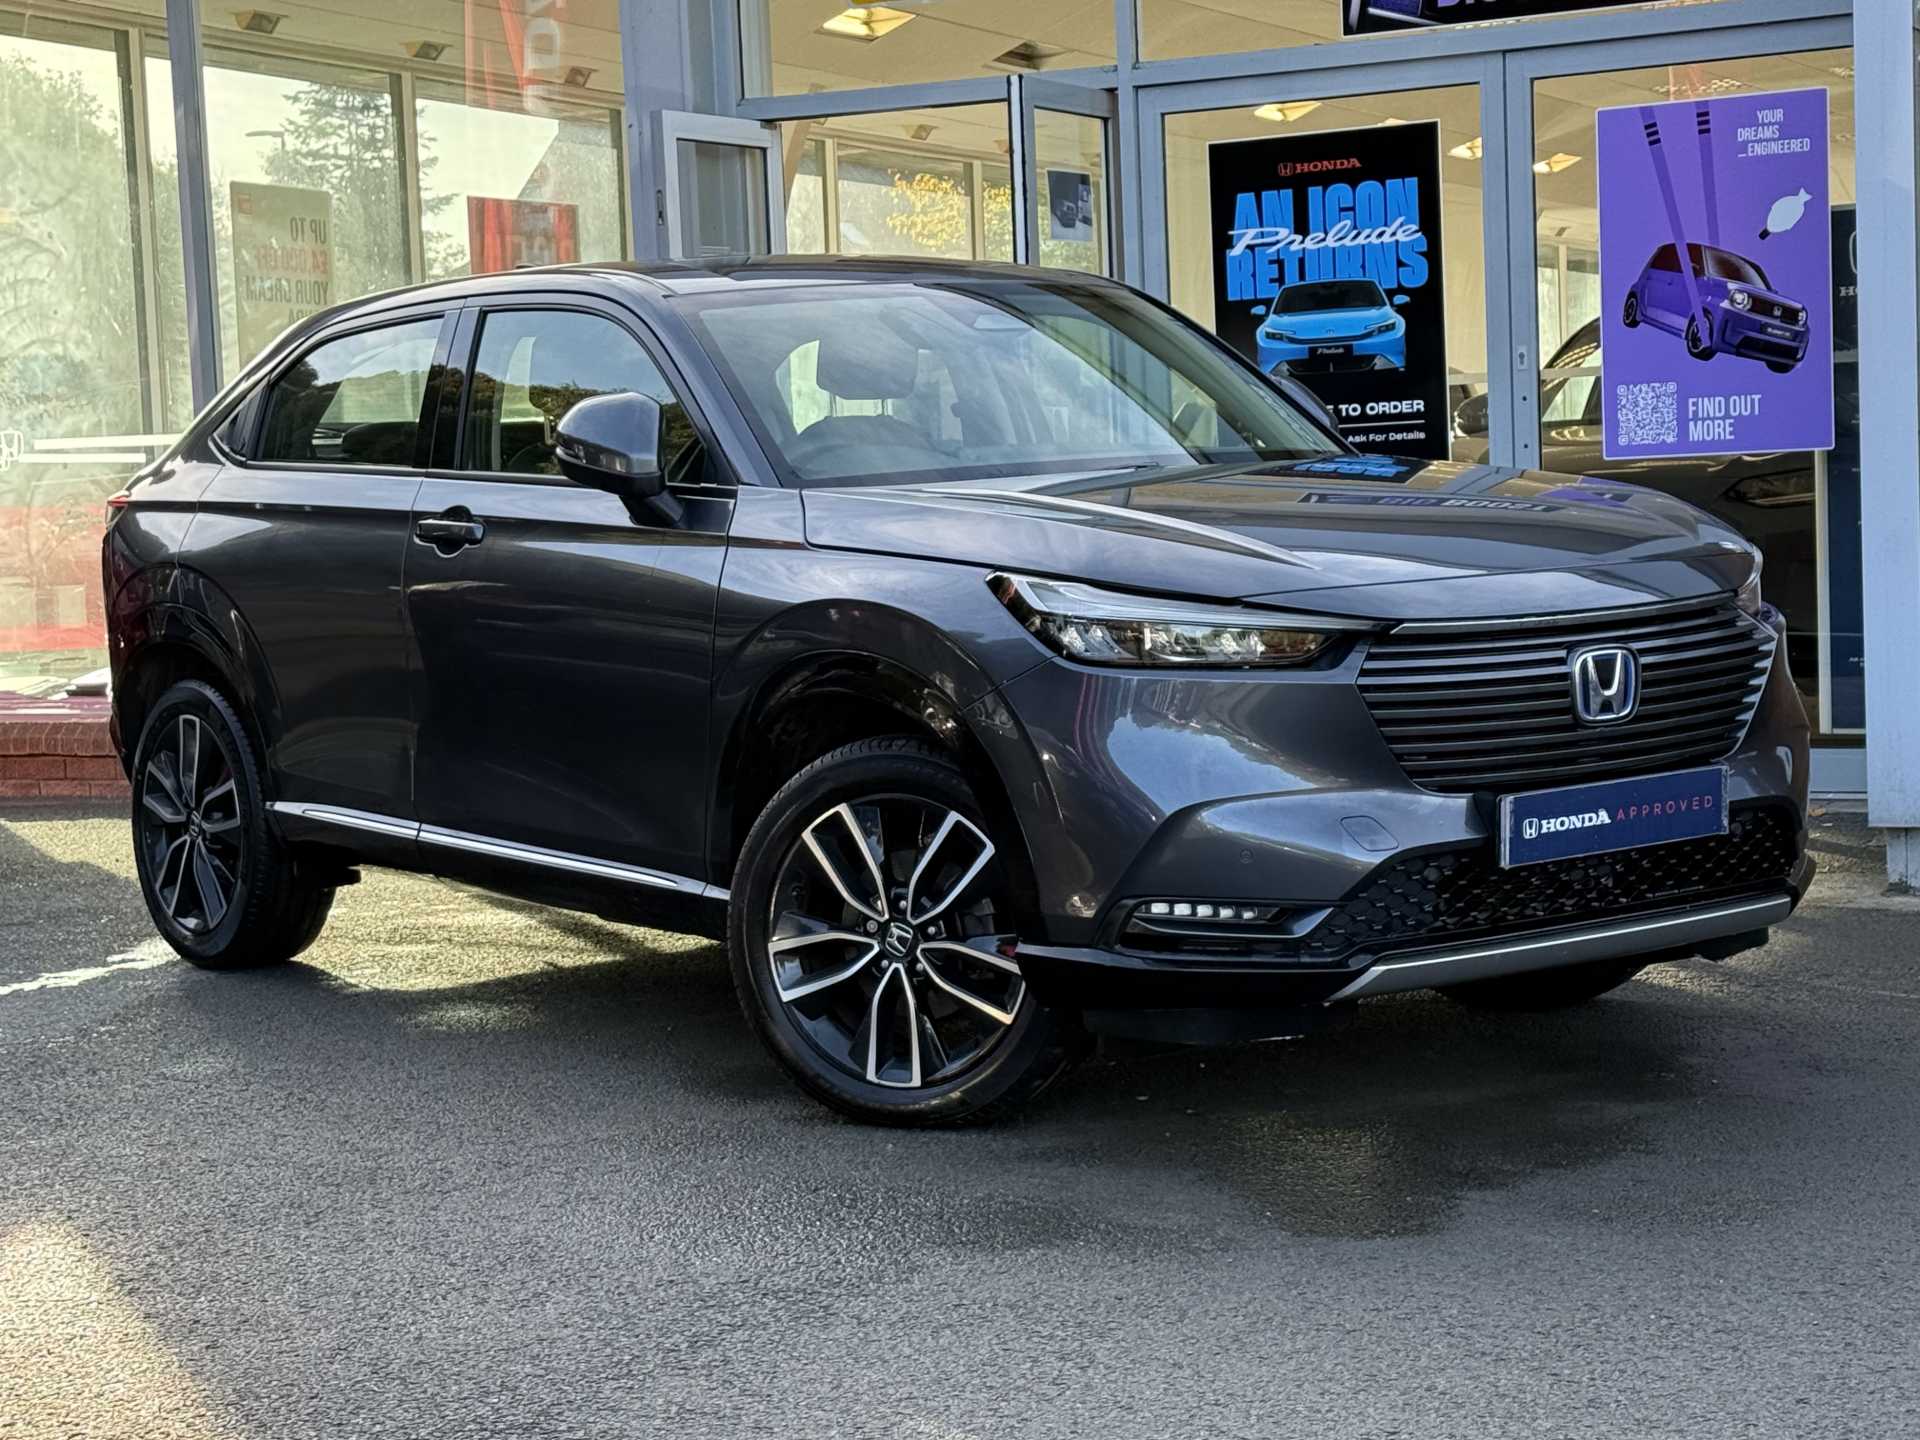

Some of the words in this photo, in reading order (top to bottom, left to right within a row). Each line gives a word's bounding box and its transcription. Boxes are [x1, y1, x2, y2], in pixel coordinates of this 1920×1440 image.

[1757, 109, 1784, 123] YOUR
[1737, 125, 1780, 141] DREAMS
[1295, 157, 1362, 174] HONDA
[1232, 188, 1294, 247] AN
[1308, 176, 1419, 238] ICON
[1227, 216, 1423, 256] Prelude
[1225, 234, 1429, 301] RETURNS
[1338, 403, 1362, 417] TO
[1365, 399, 1425, 416] ORDER
[1688, 396, 1726, 419] FIND
[1729, 394, 1762, 417] OUT
[1347, 434, 1367, 443] Ask
[1369, 432, 1387, 442] For
[1388, 430, 1426, 441] Details
[1689, 419, 1735, 442] MORE
[1540, 808, 1612, 834] HONDA
[1616, 795, 1714, 822] APPROVED
